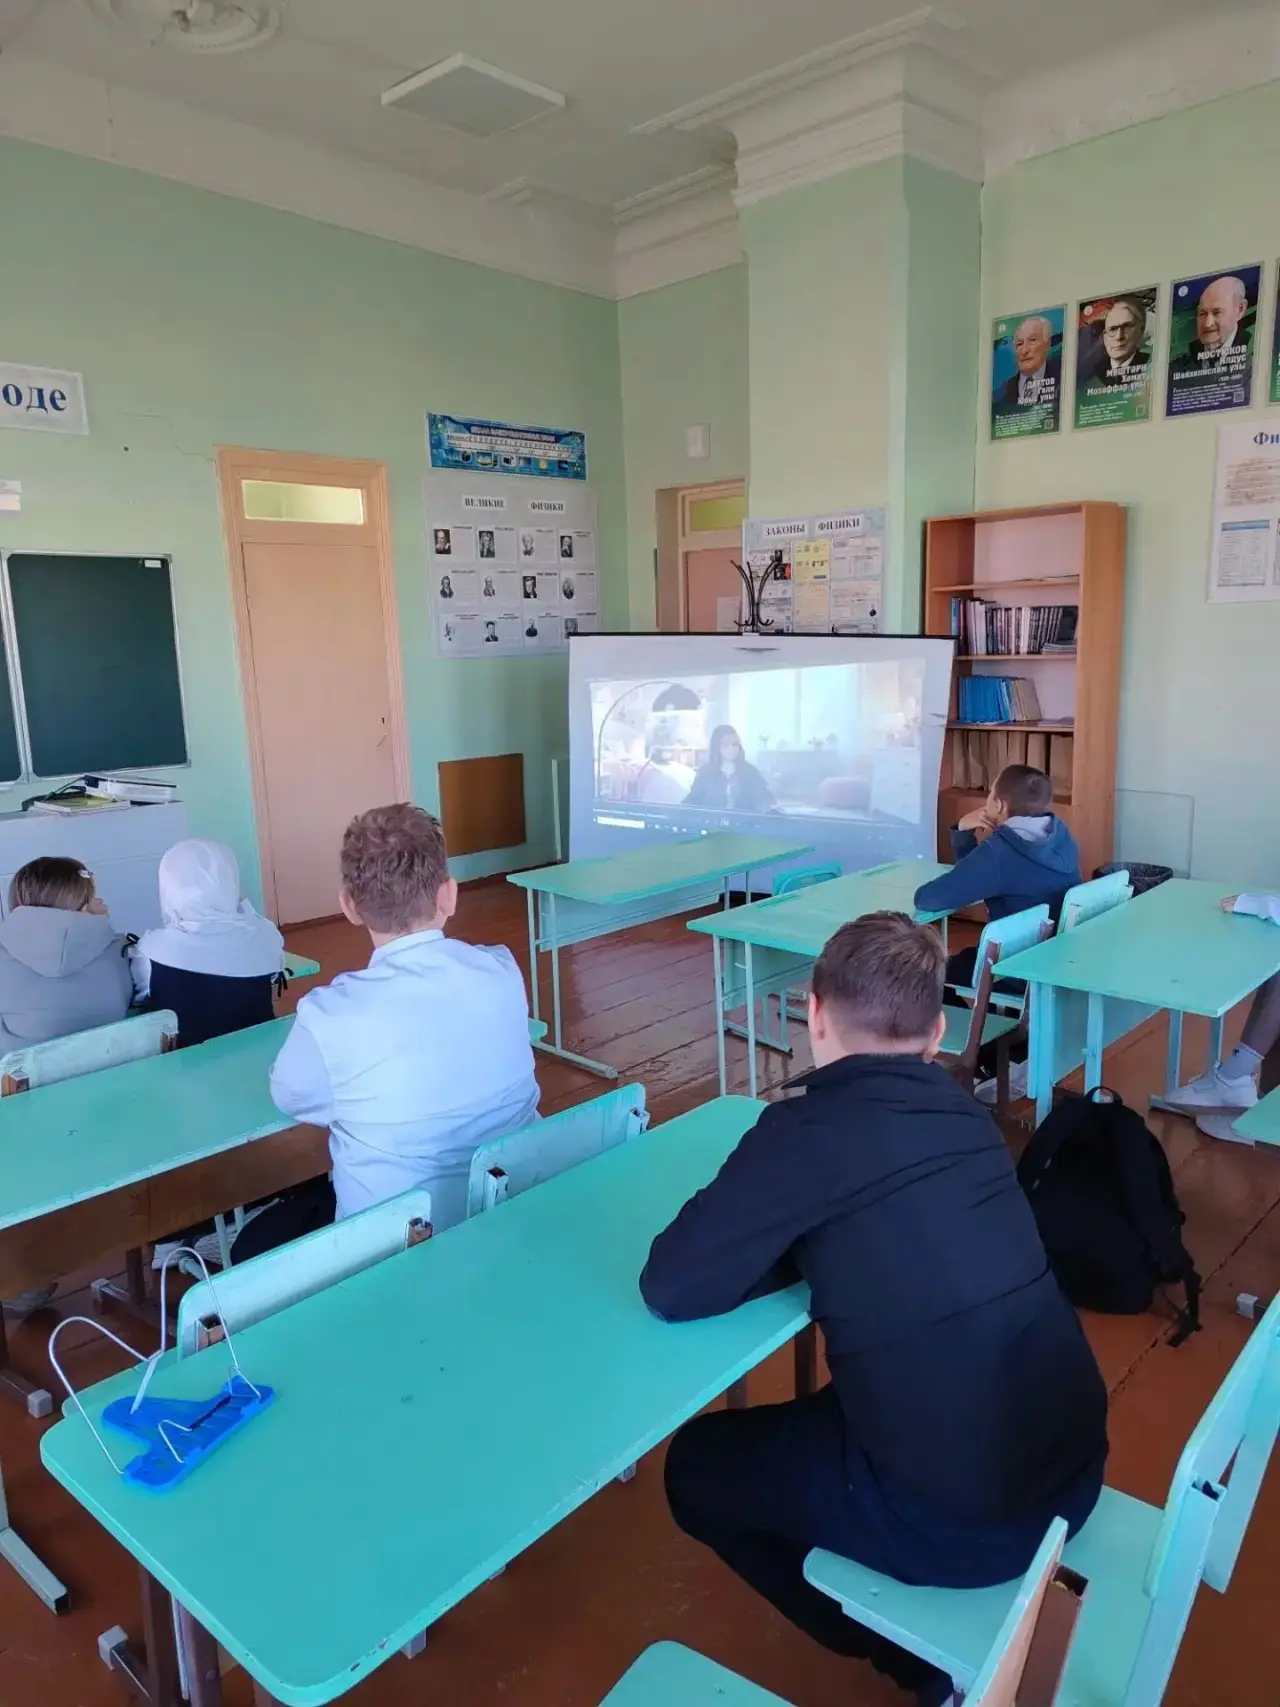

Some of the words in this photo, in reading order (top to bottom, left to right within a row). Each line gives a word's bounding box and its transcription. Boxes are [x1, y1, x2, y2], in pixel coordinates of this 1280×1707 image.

[1197, 344, 1247, 360] МОСТЮКОВ
[1026, 376, 1056, 389] ДАУТОВ
[2, 383, 67, 414] оде
[464, 497, 505, 508] ВЕЛИКИЕ
[530, 500, 565, 512] ФИЗИКИ
[765, 522, 805, 536] ЗАКОНЫ
[817, 517, 860, 532] ФИЗИКИ
